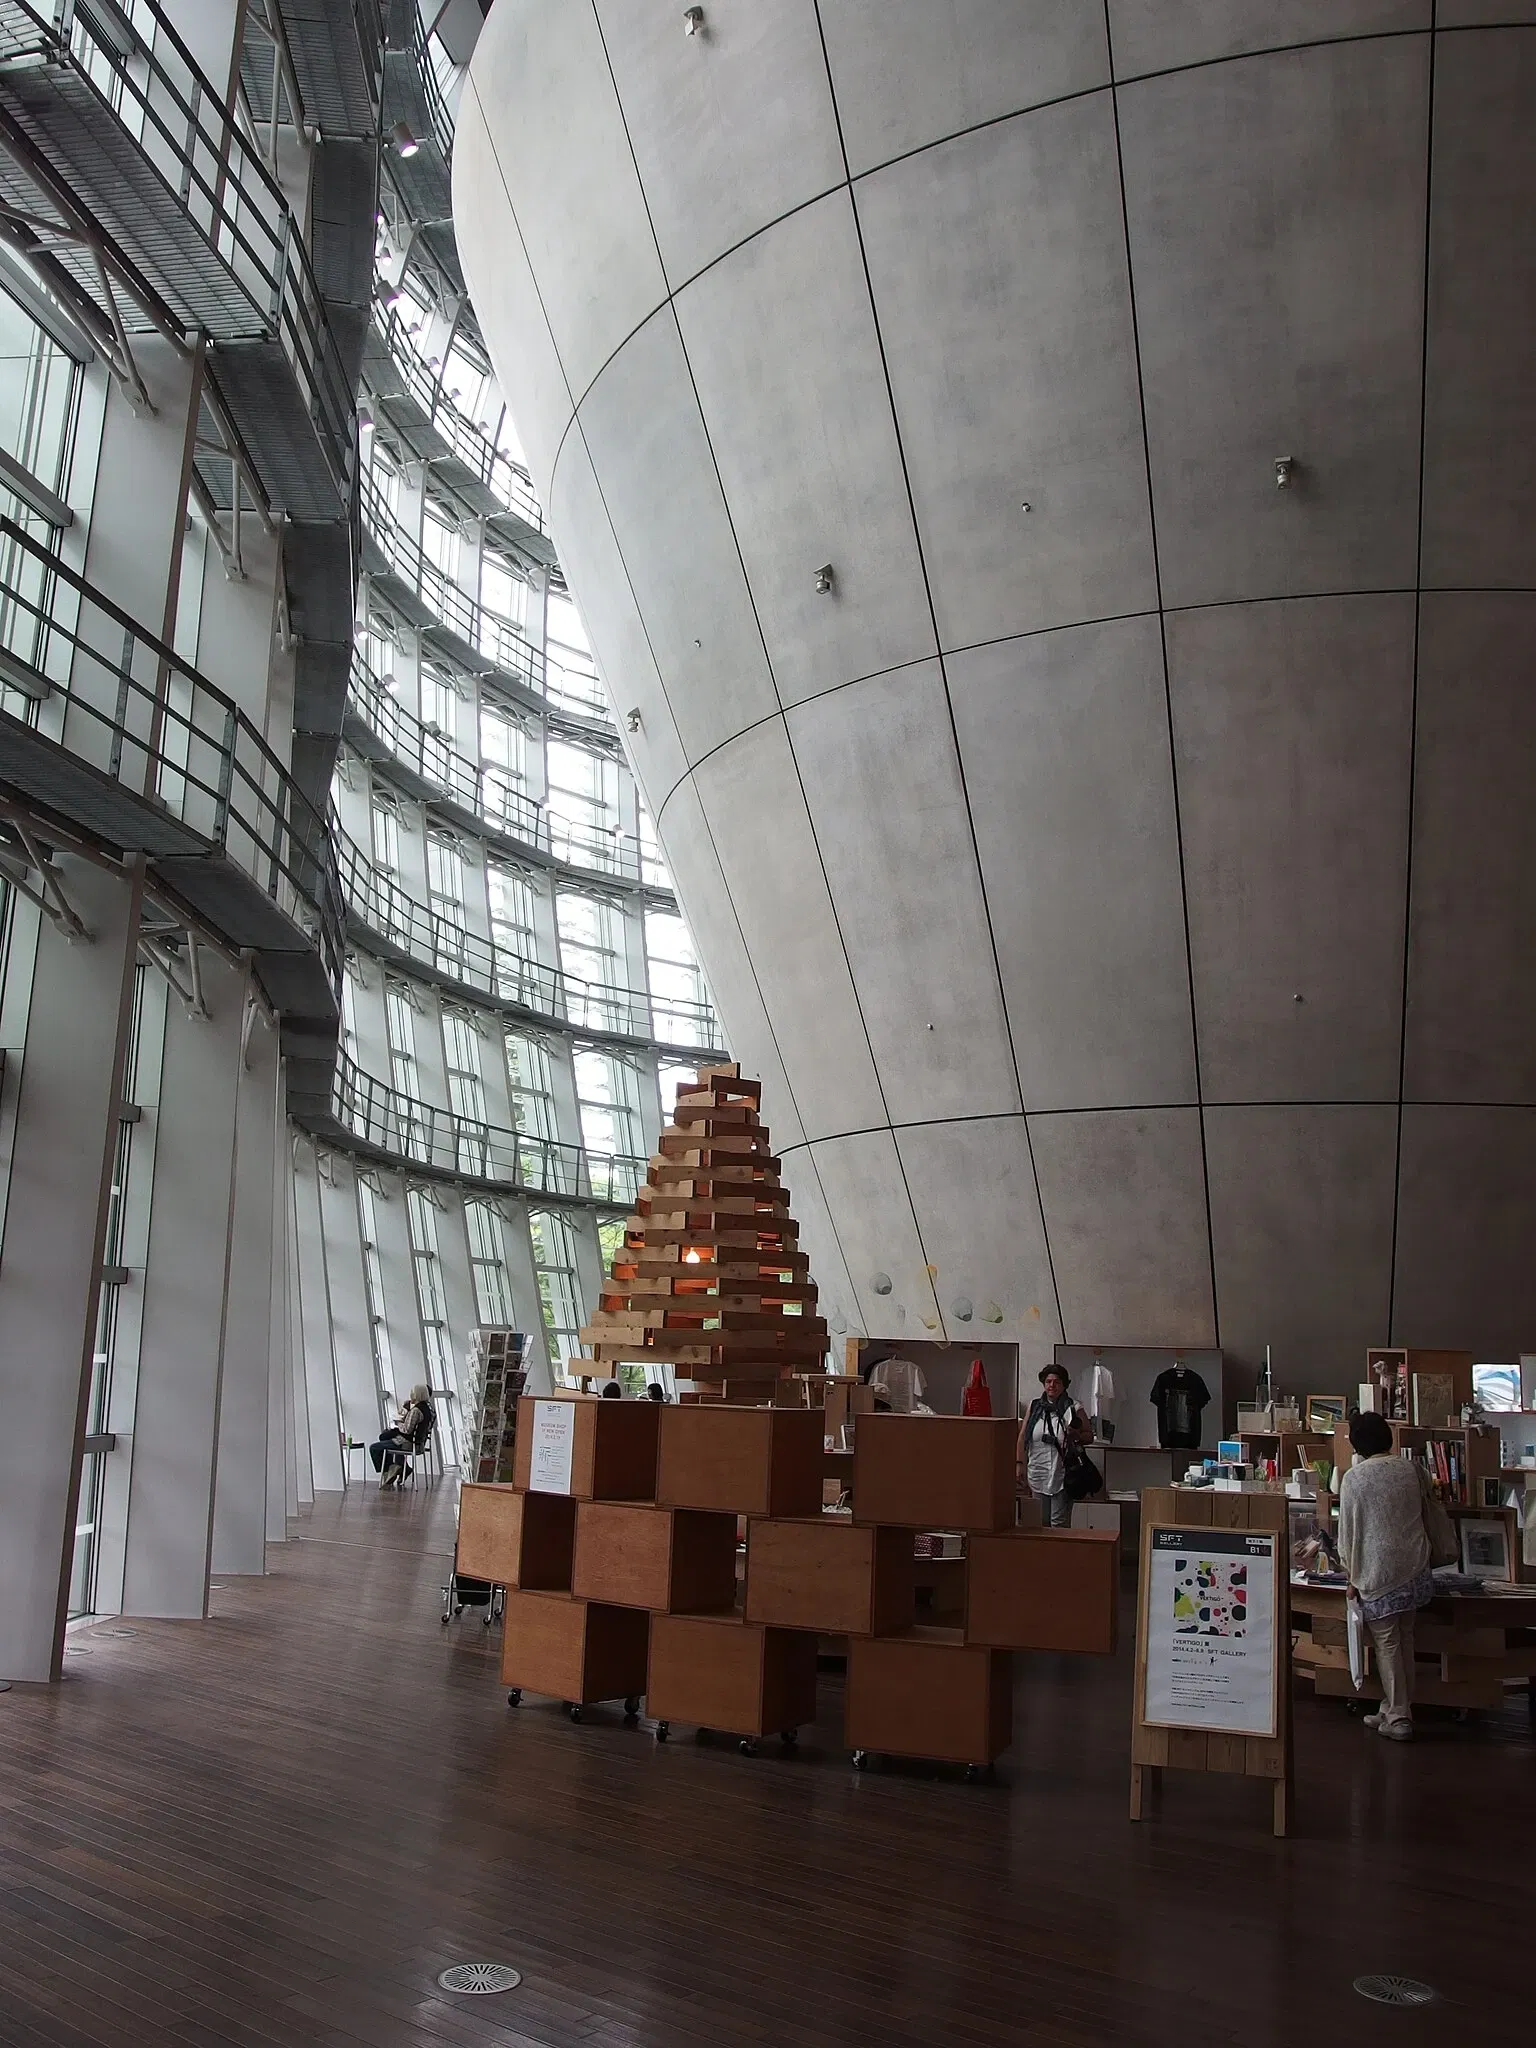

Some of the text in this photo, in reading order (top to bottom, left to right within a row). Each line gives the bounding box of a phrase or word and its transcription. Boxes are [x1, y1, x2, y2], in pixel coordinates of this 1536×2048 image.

[1159, 1534, 1183, 1542] SFT
[1250, 1546, 1260, 1554] B1
[1220, 1649, 1247, 1657] GALLERY
